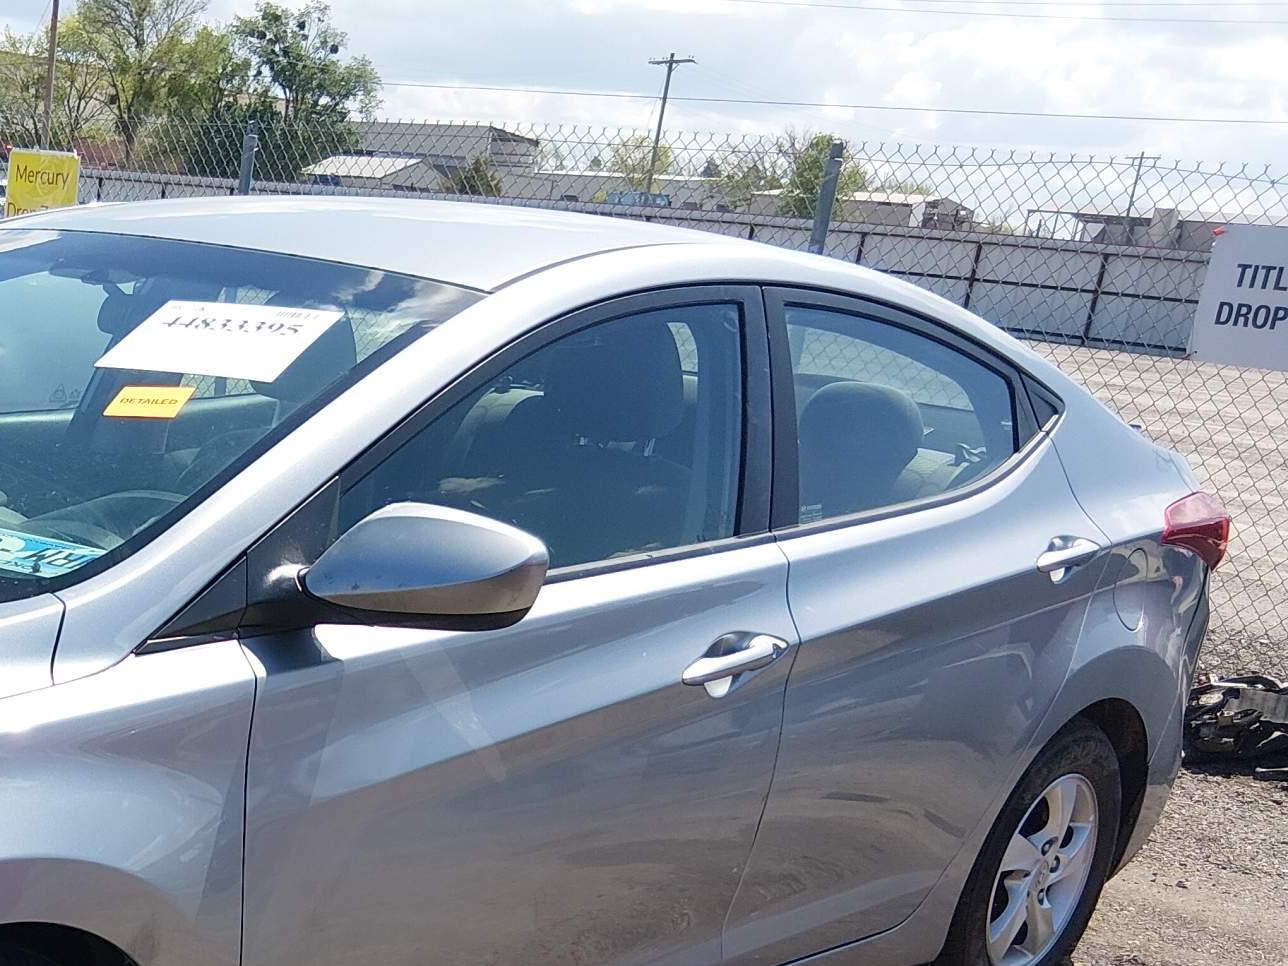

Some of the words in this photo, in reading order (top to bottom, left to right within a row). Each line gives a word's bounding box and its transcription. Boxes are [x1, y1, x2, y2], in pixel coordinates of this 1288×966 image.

[15, 164, 70, 190] Mercury
[7, 202, 36, 217] Dr
[1236, 264, 1288, 291] TITL
[161, 316, 304, 336] 44833395
[1214, 301, 1288, 330] DROP
